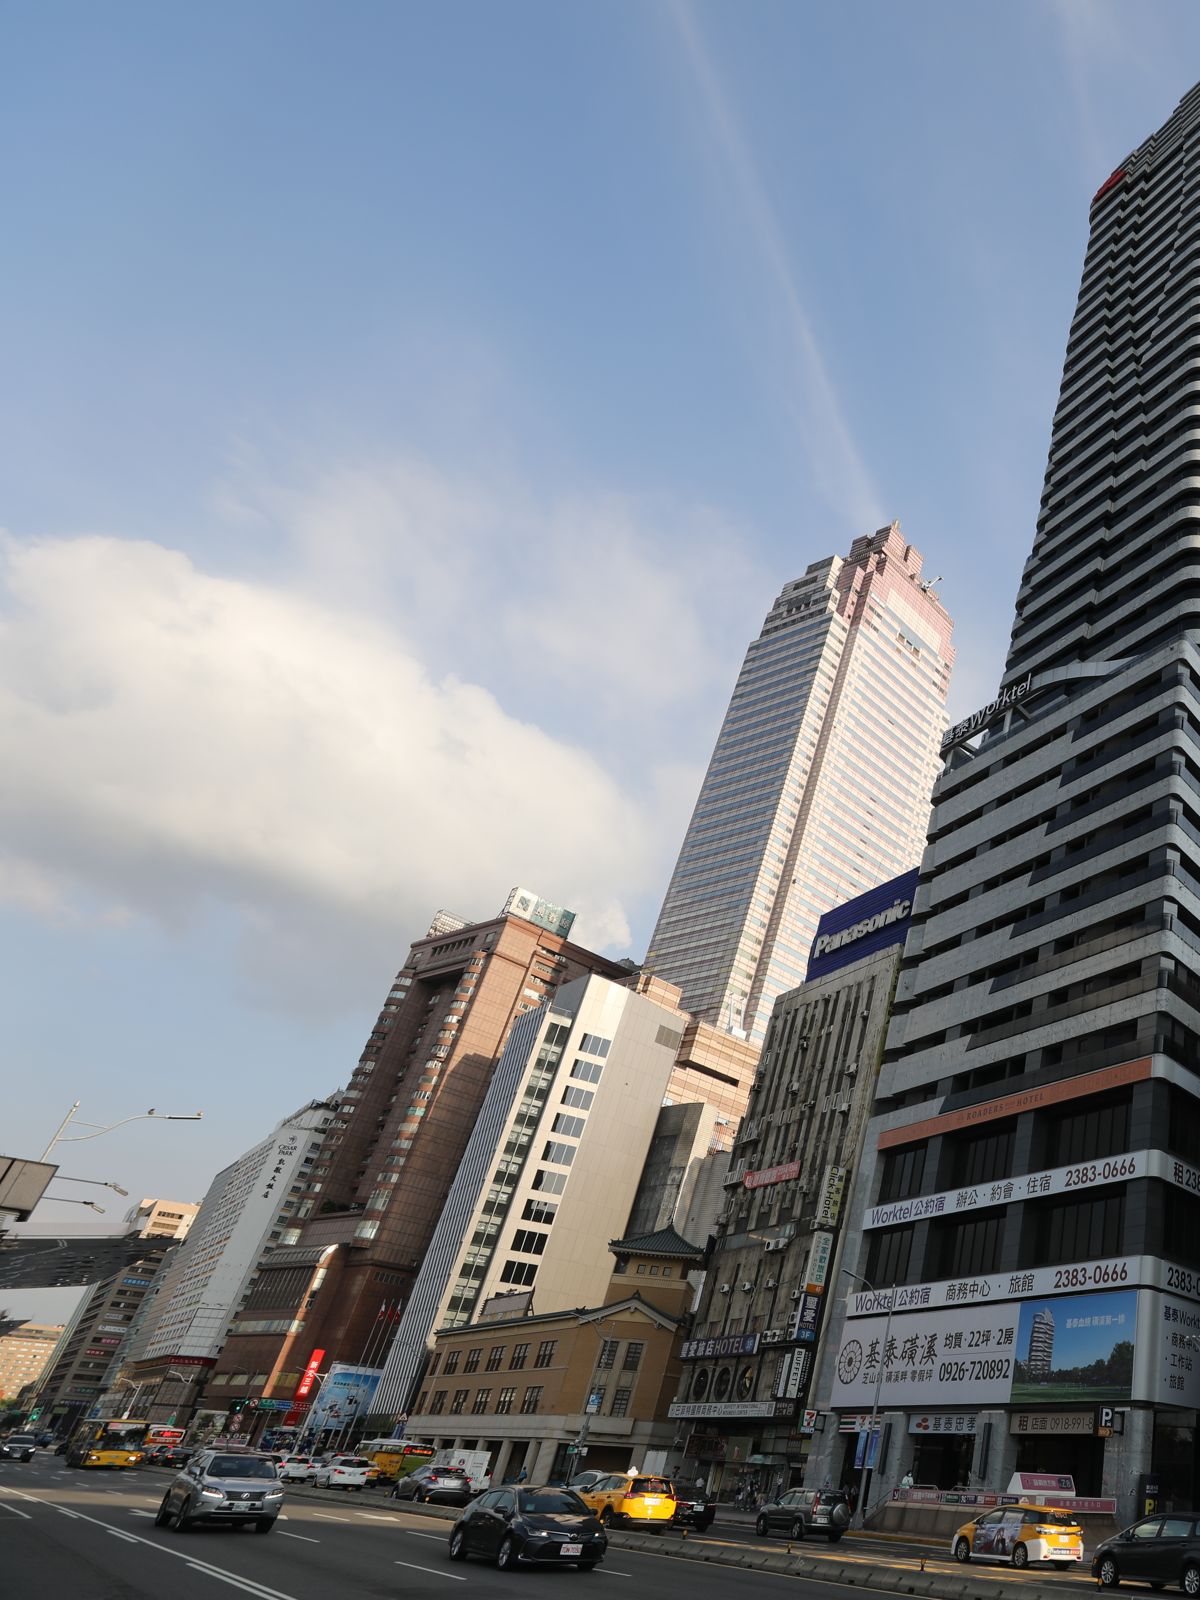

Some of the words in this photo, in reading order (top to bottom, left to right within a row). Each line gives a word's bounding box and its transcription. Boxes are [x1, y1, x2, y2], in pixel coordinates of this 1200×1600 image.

[813, 898, 911, 959] Panasonic
[966, 1104, 1004, 1120] ROADERS
[1016, 1093, 1044, 1107] HOTEL
[1064, 1157, 1136, 1188] 2383-0666
[1054, 1262, 1128, 1289] 2383-0666
[790, 1350, 804, 1388] BUFFETT
[939, 1358, 1011, 1383] 0926-720892
[932, 1416, 976, 1432] 基泰忠孝
[1102, 1408, 1112, 1427] P
